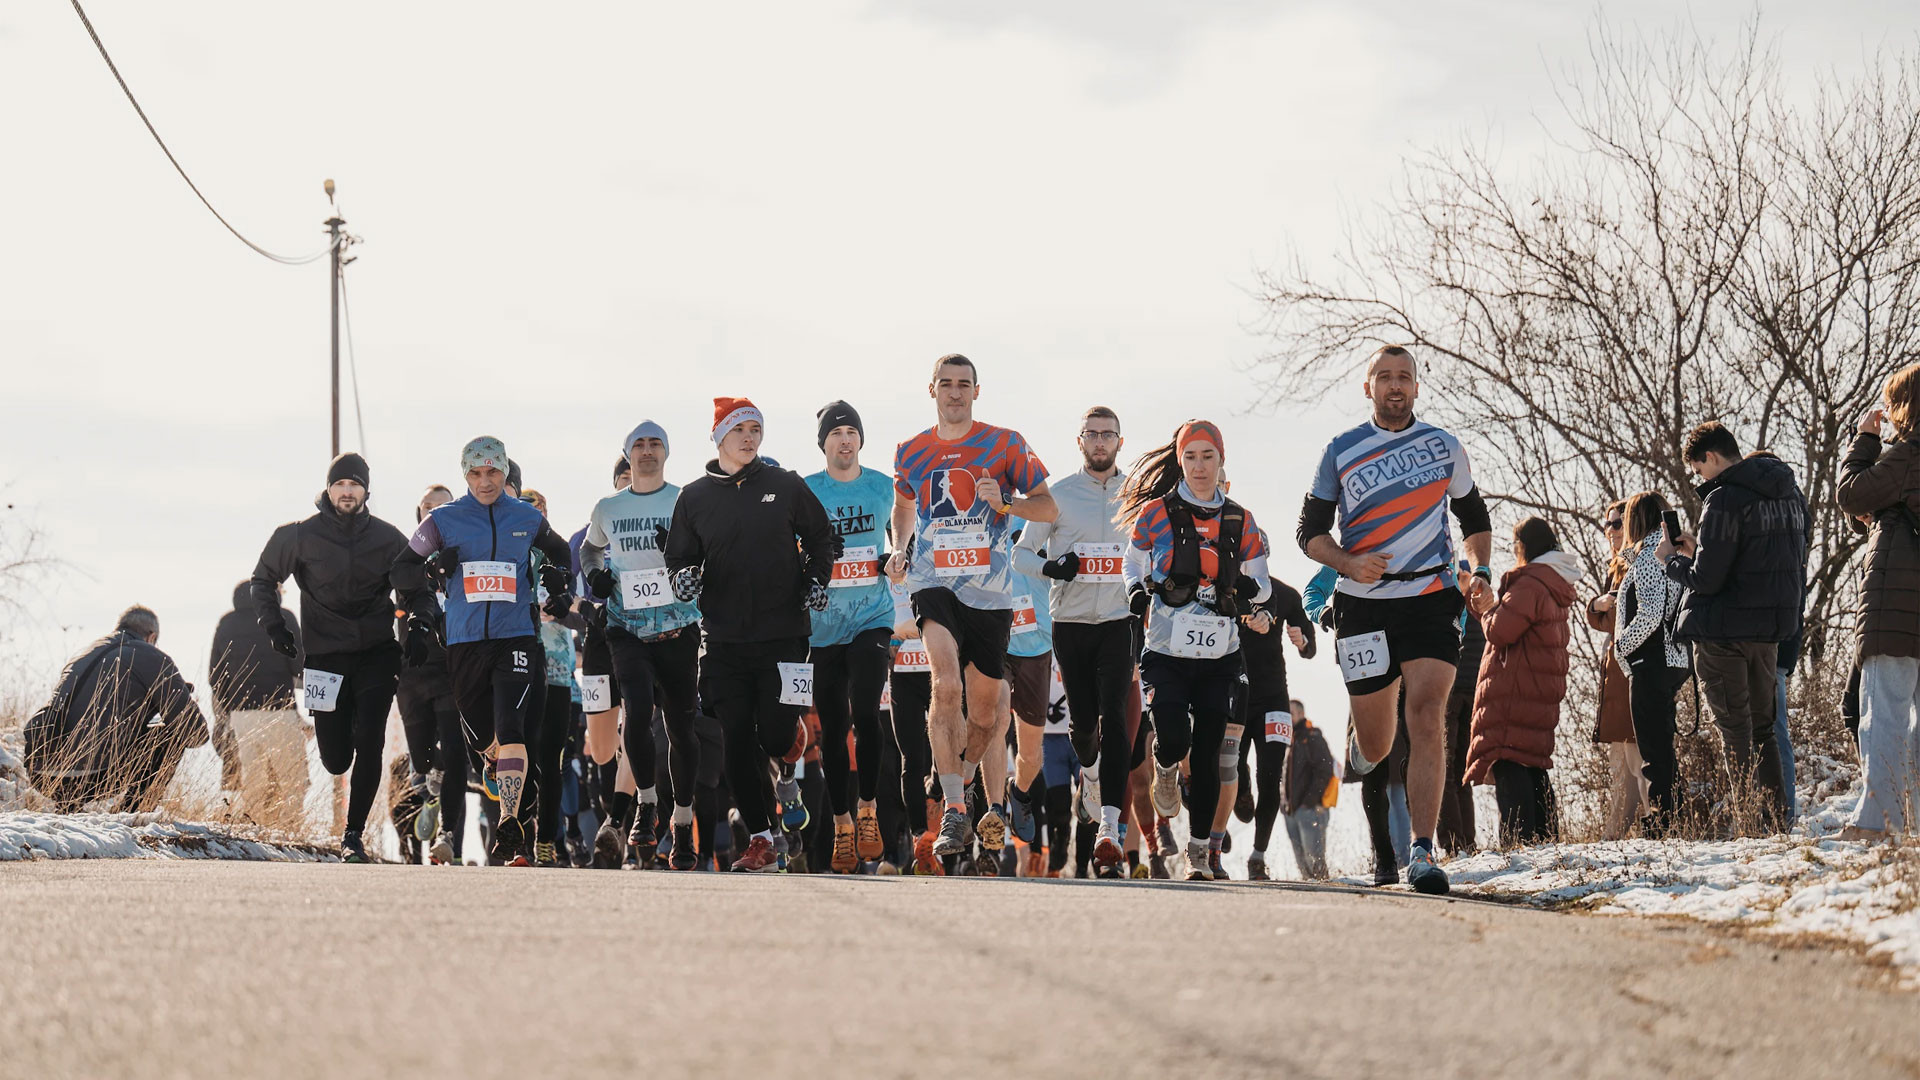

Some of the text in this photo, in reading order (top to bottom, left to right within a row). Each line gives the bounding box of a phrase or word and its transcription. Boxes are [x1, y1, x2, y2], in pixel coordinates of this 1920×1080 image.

[1347, 437, 1450, 501] АРИЉЕ
[1404, 466, 1447, 488] СРБИЈА
[831, 517, 874, 535] TEAM
[947, 550, 978, 566] 033
[841, 562, 869, 578] 034
[1086, 559, 1114, 574] 019
[476, 577, 505, 592] 021
[633, 582, 660, 598] 502
[1185, 630, 1216, 647] 516
[512, 650, 528, 666] 15
[903, 653, 927, 665] 018
[1347, 649, 1377, 669] 512
[305, 684, 326, 700] 504
[792, 679, 813, 694] 520
